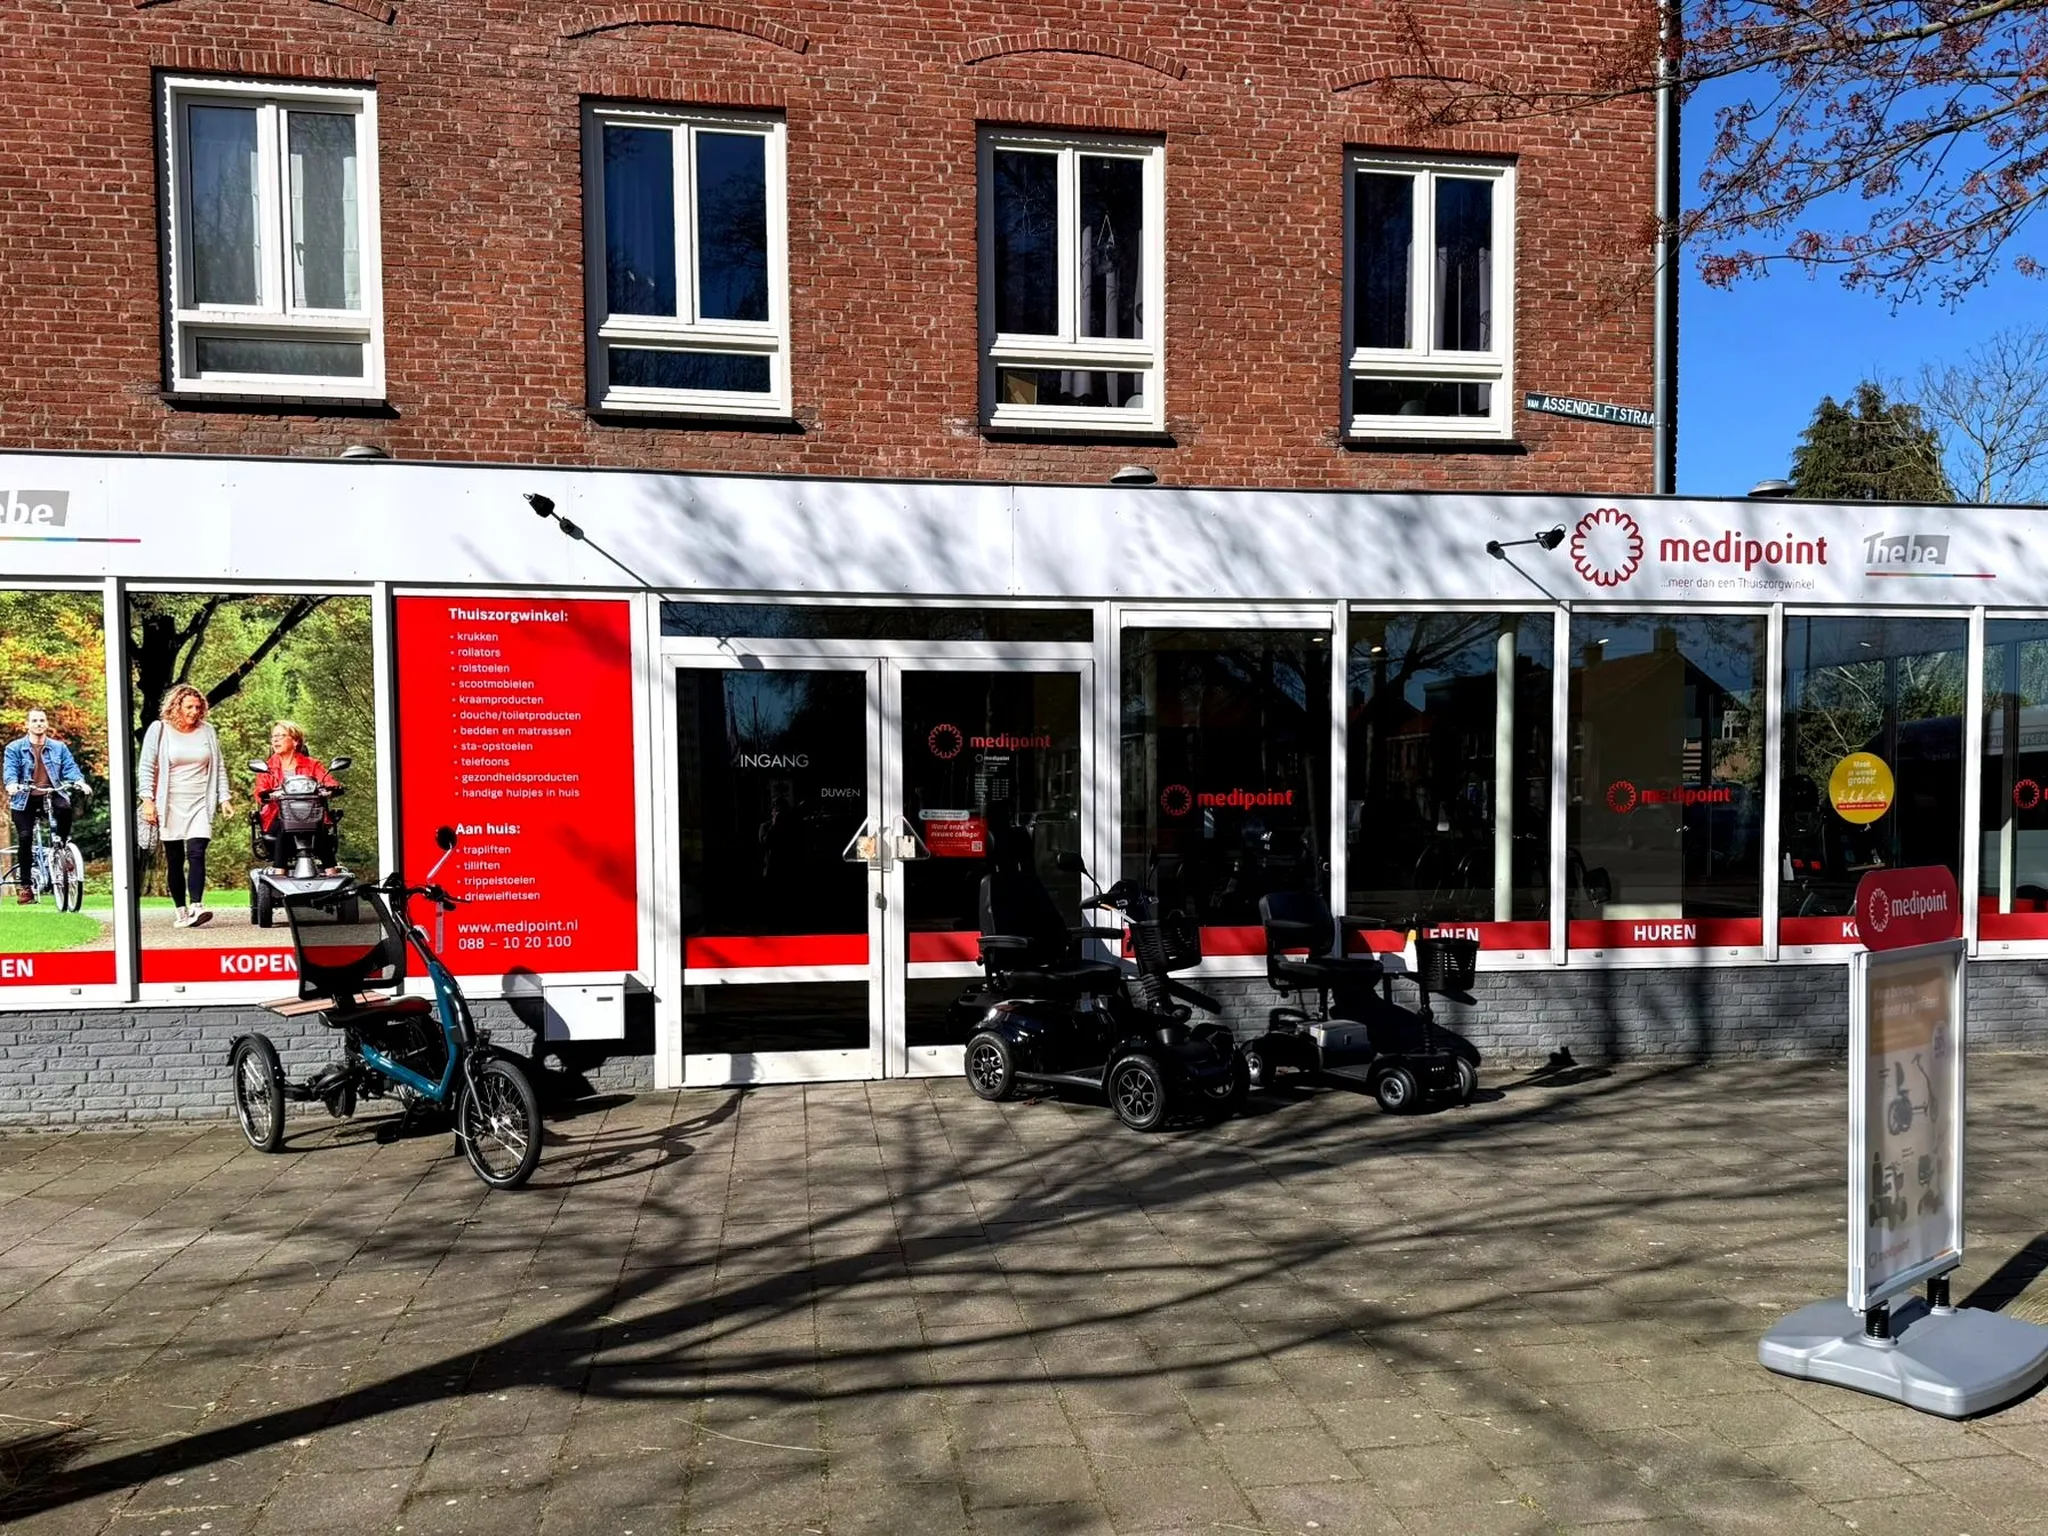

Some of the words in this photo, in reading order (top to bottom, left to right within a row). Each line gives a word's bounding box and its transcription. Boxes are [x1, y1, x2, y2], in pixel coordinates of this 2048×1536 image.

[0, 490, 54, 524] be
[1660, 530, 1827, 571] medipoint
[1863, 531, 1939, 565] Thebe
[1696, 577, 1715, 588] dan
[1717, 579, 1735, 588] een
[1738, 577, 1815, 591] Thuiszorgwinkel
[448, 607, 569, 623] Thuiszorgwinkel:
[457, 632, 498, 641] krukken
[458, 648, 501, 657] rollators
[459, 664, 510, 673] rolstoelen
[459, 679, 534, 689] scootmobielen
[459, 695, 544, 705] kraamproducten
[460, 710, 581, 721] douche/toiletproducten
[460, 726, 499, 735] bedden
[518, 727, 571, 736] matrassen
[460, 742, 533, 752] sta-opstoelen
[970, 732, 1051, 751] medipoint
[461, 757, 510, 766] telefoons
[740, 754, 809, 767] INGANG
[461, 772, 579, 784] gezondheidsproducten
[462, 788, 503, 799] handige
[506, 788, 543, 799] hulpjes
[546, 788, 556, 797] in
[558, 788, 580, 797] huis
[821, 788, 860, 798] DUWEN
[1197, 788, 1294, 810] medipoint
[1641, 785, 1731, 807] medipoint
[455, 823, 482, 835] Aan
[486, 823, 521, 834] huis:
[463, 845, 511, 856] trapliften
[464, 861, 500, 870] tilliften
[464, 876, 535, 889] trippelstoelen
[464, 891, 540, 901] driewielfietsen
[1891, 889, 1948, 920] medipoint
[458, 920, 578, 934] www.medipoint.nl
[1633, 924, 1697, 941] HUREN
[1429, 927, 1479, 942] ENEN
[458, 938, 485, 950] 088
[503, 937, 520, 949] 10
[524, 936, 542, 948] 20
[547, 936, 571, 947] 100
[220, 954, 298, 973] KOPEN
